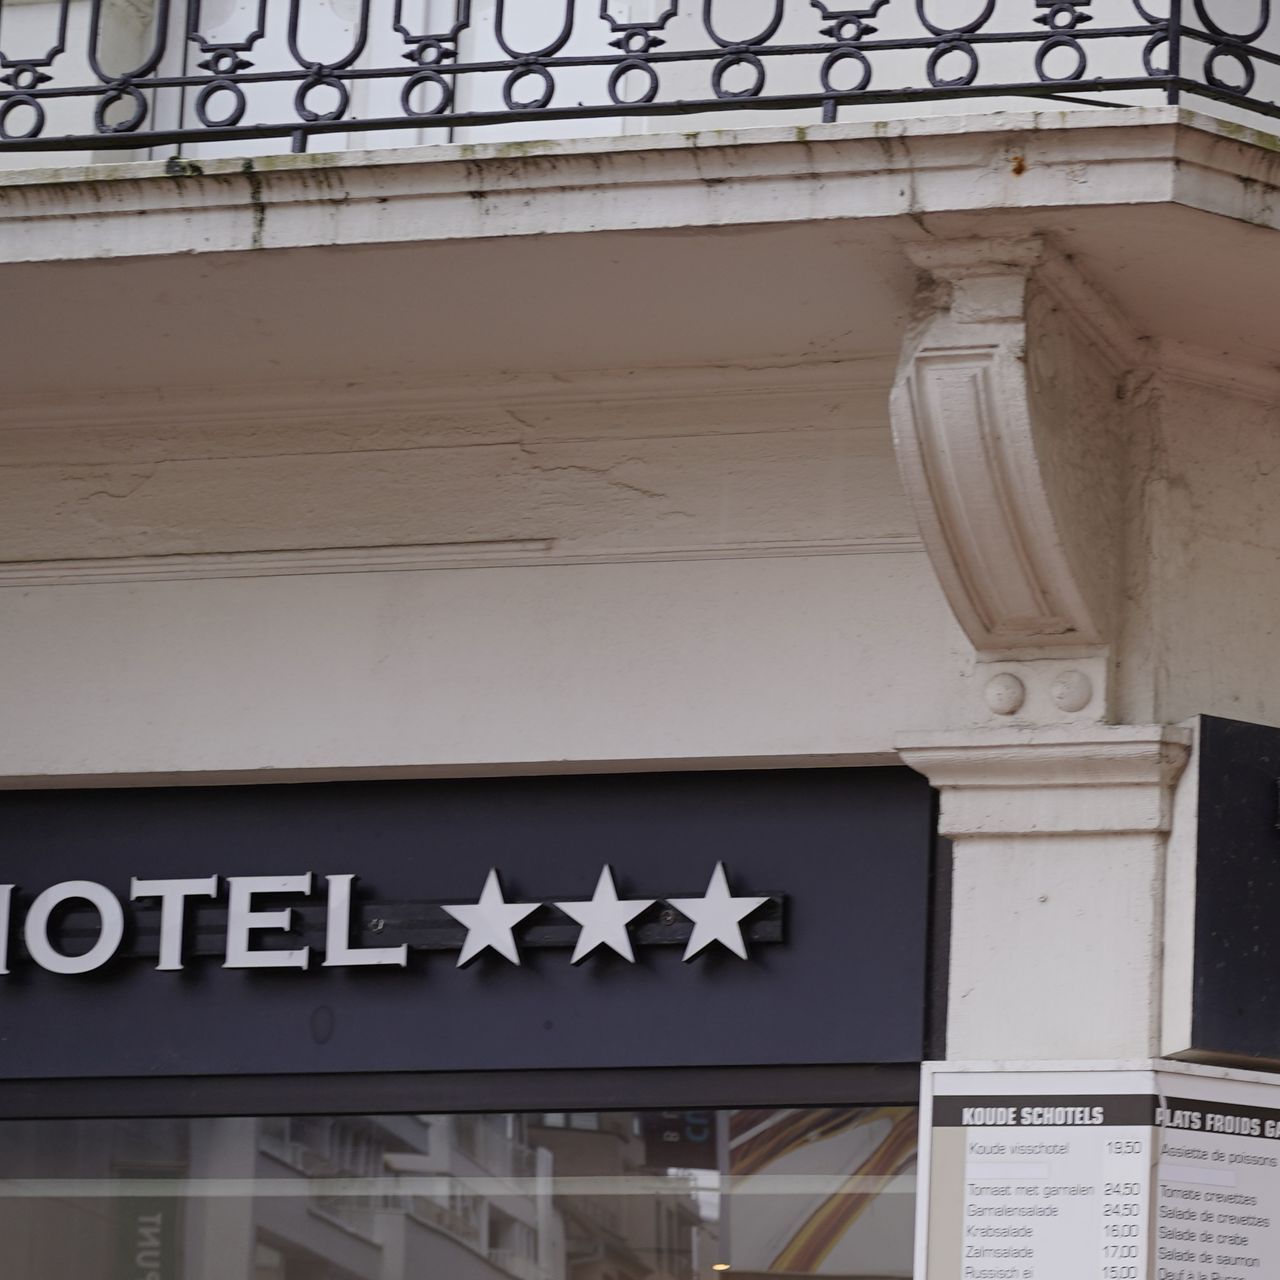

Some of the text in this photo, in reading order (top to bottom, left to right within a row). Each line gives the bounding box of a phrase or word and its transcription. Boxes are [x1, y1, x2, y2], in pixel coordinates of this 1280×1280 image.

[0, 868, 408, 975] OTEL
[962, 1107, 1104, 1125] KOUDE SCHOTELS
[1155, 1108, 1201, 1130] PLATS
[1206, 1113, 1261, 1135] FROIDS
